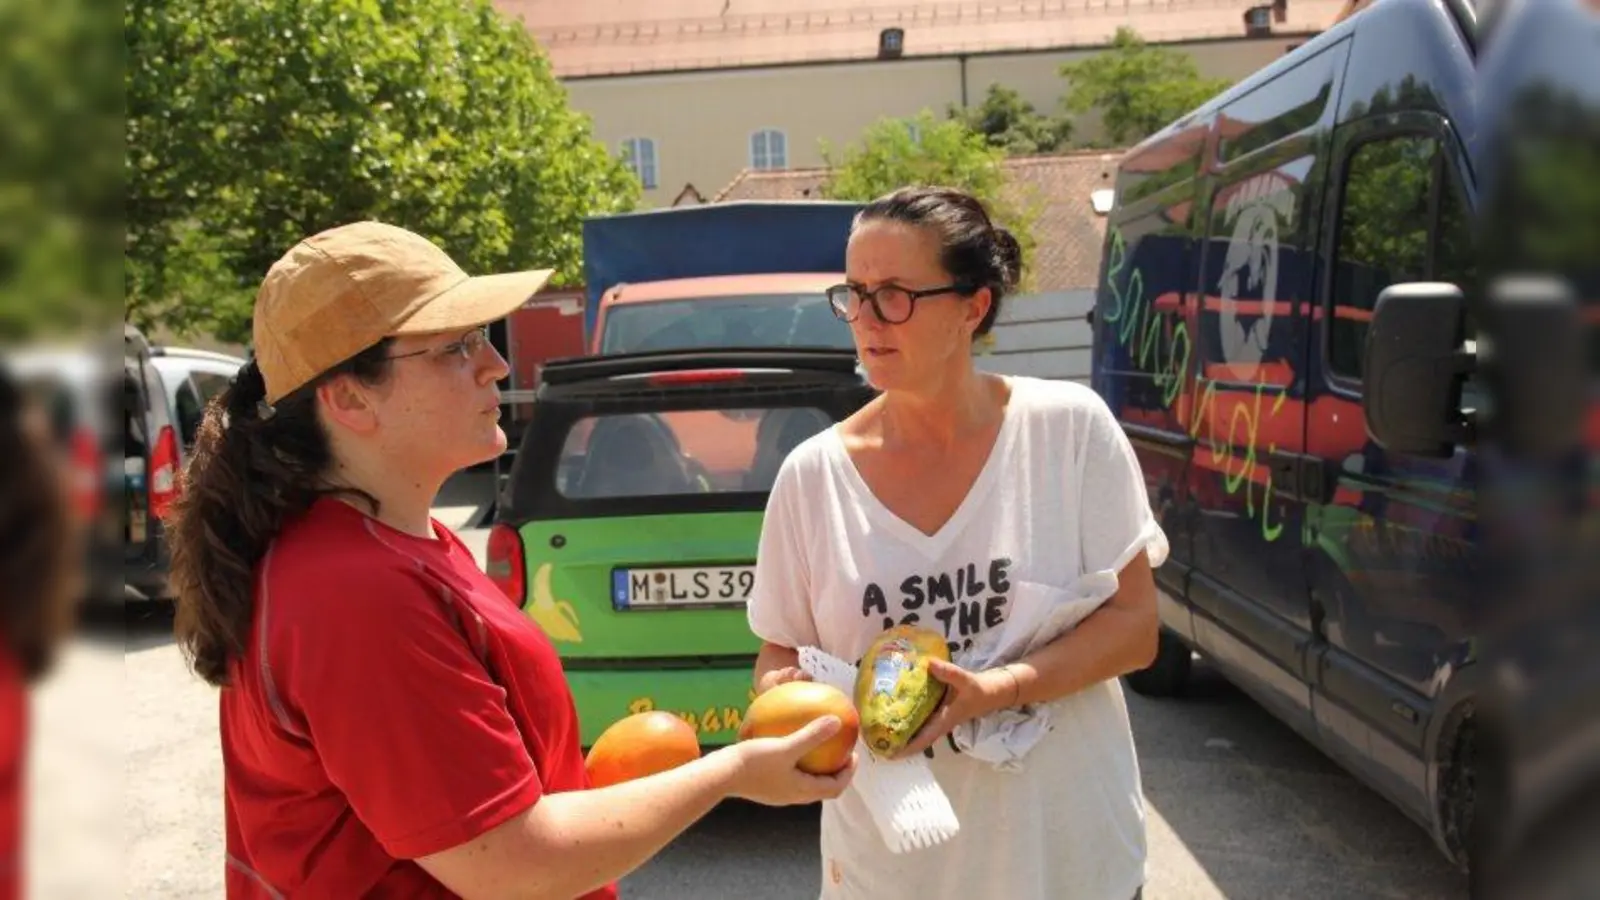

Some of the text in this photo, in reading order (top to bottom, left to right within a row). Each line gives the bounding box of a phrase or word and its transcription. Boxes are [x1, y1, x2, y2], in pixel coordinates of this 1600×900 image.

[632, 574, 649, 600] M
[862, 558, 1012, 617] A SMILE
[934, 596, 1008, 639] THE
